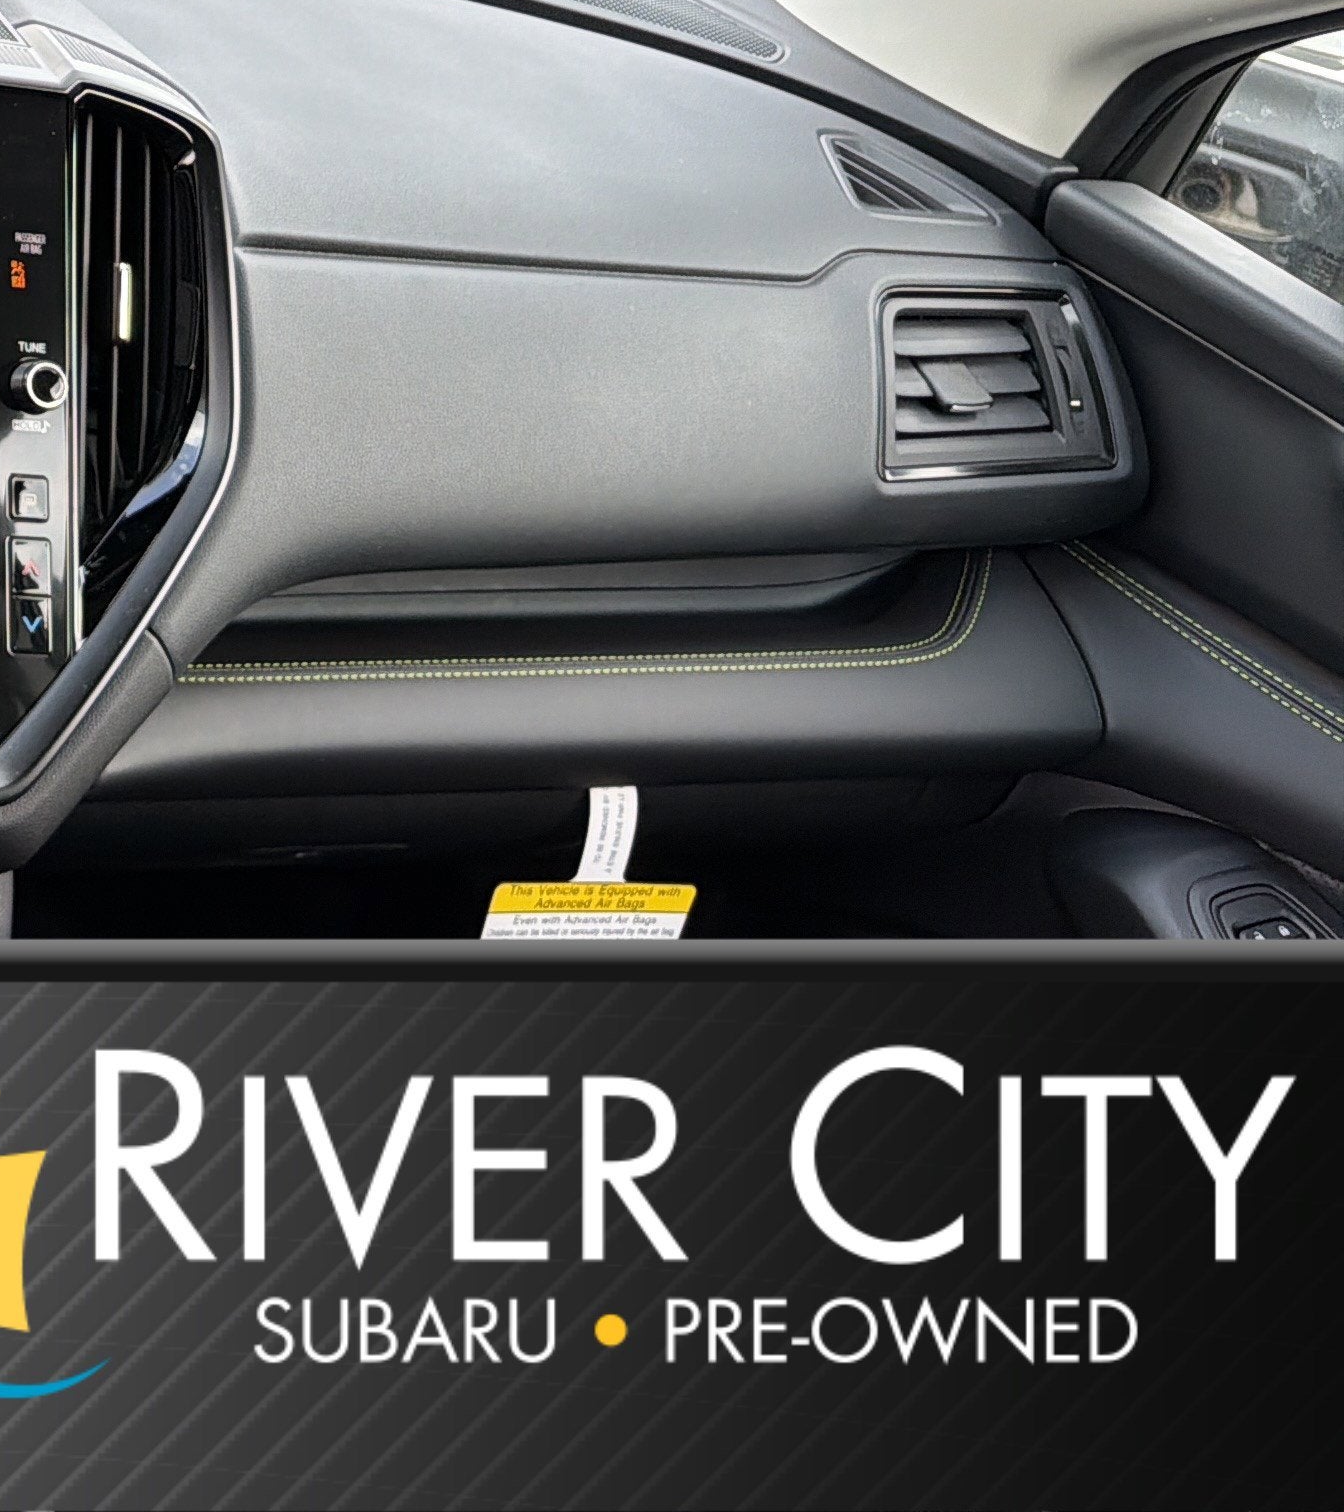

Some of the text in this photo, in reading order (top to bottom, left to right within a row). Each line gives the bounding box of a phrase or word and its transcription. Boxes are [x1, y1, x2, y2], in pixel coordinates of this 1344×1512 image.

[17, 340, 47, 355] TUNE
[510, 885, 533, 896] This
[539, 885, 579, 896] Vehicle
[599, 885, 653, 900] Equipped
[657, 887, 681, 898] with
[534, 897, 592, 909] Advanced
[616, 897, 645, 910] Bags
